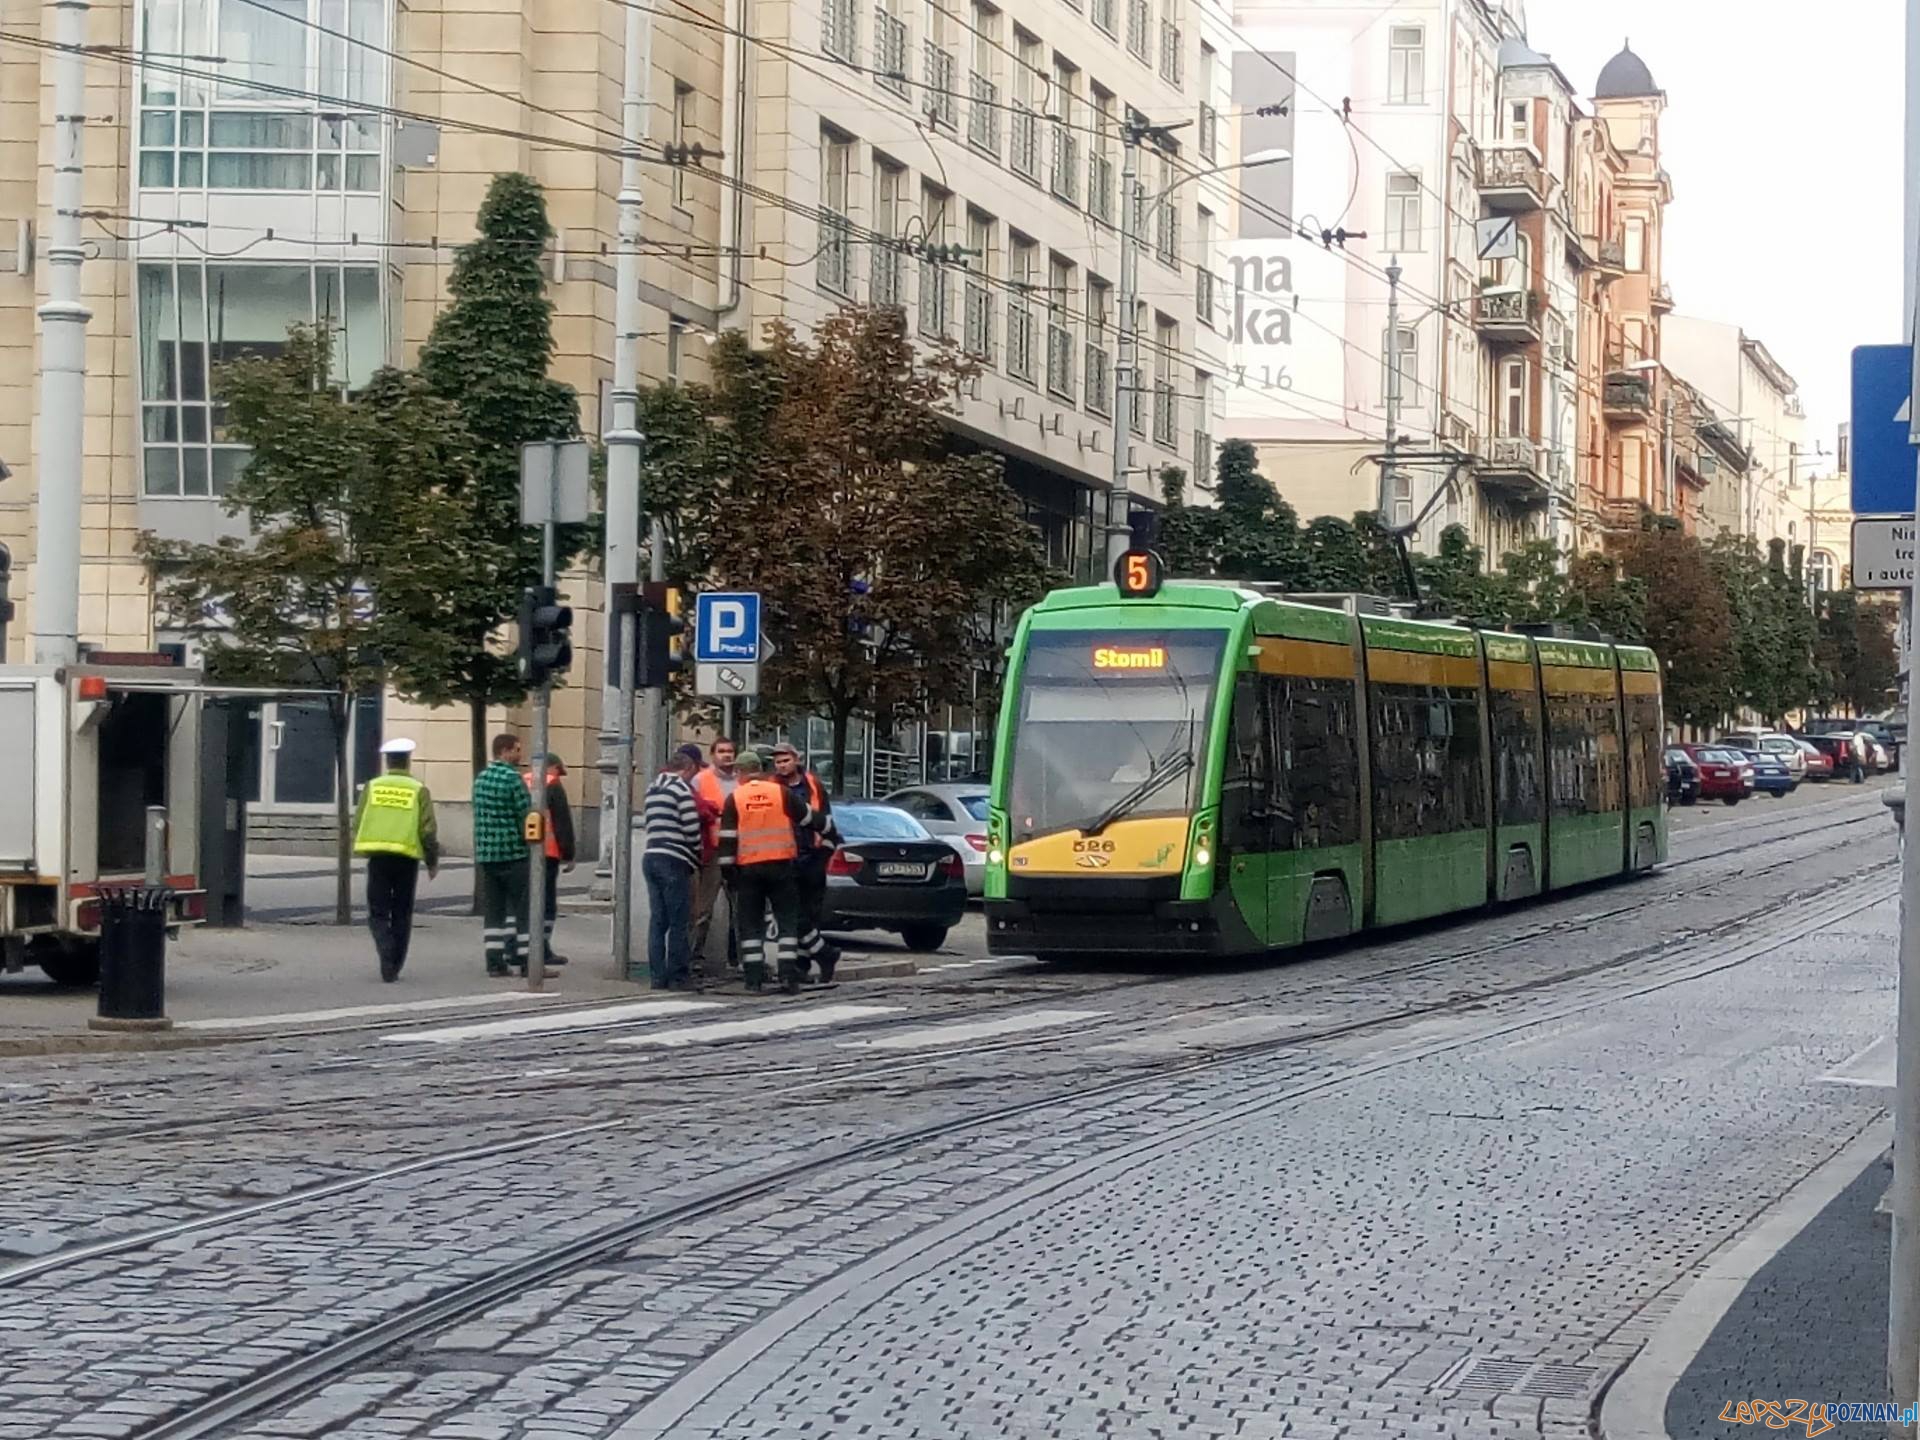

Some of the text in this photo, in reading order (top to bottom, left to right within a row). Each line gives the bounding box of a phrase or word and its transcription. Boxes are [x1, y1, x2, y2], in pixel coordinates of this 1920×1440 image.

[1227, 293, 1292, 345] ka
[1260, 364, 1293, 391] 16
[1127, 555, 1148, 590] 5
[710, 601, 745, 653] P
[1072, 839, 1116, 853] 526
